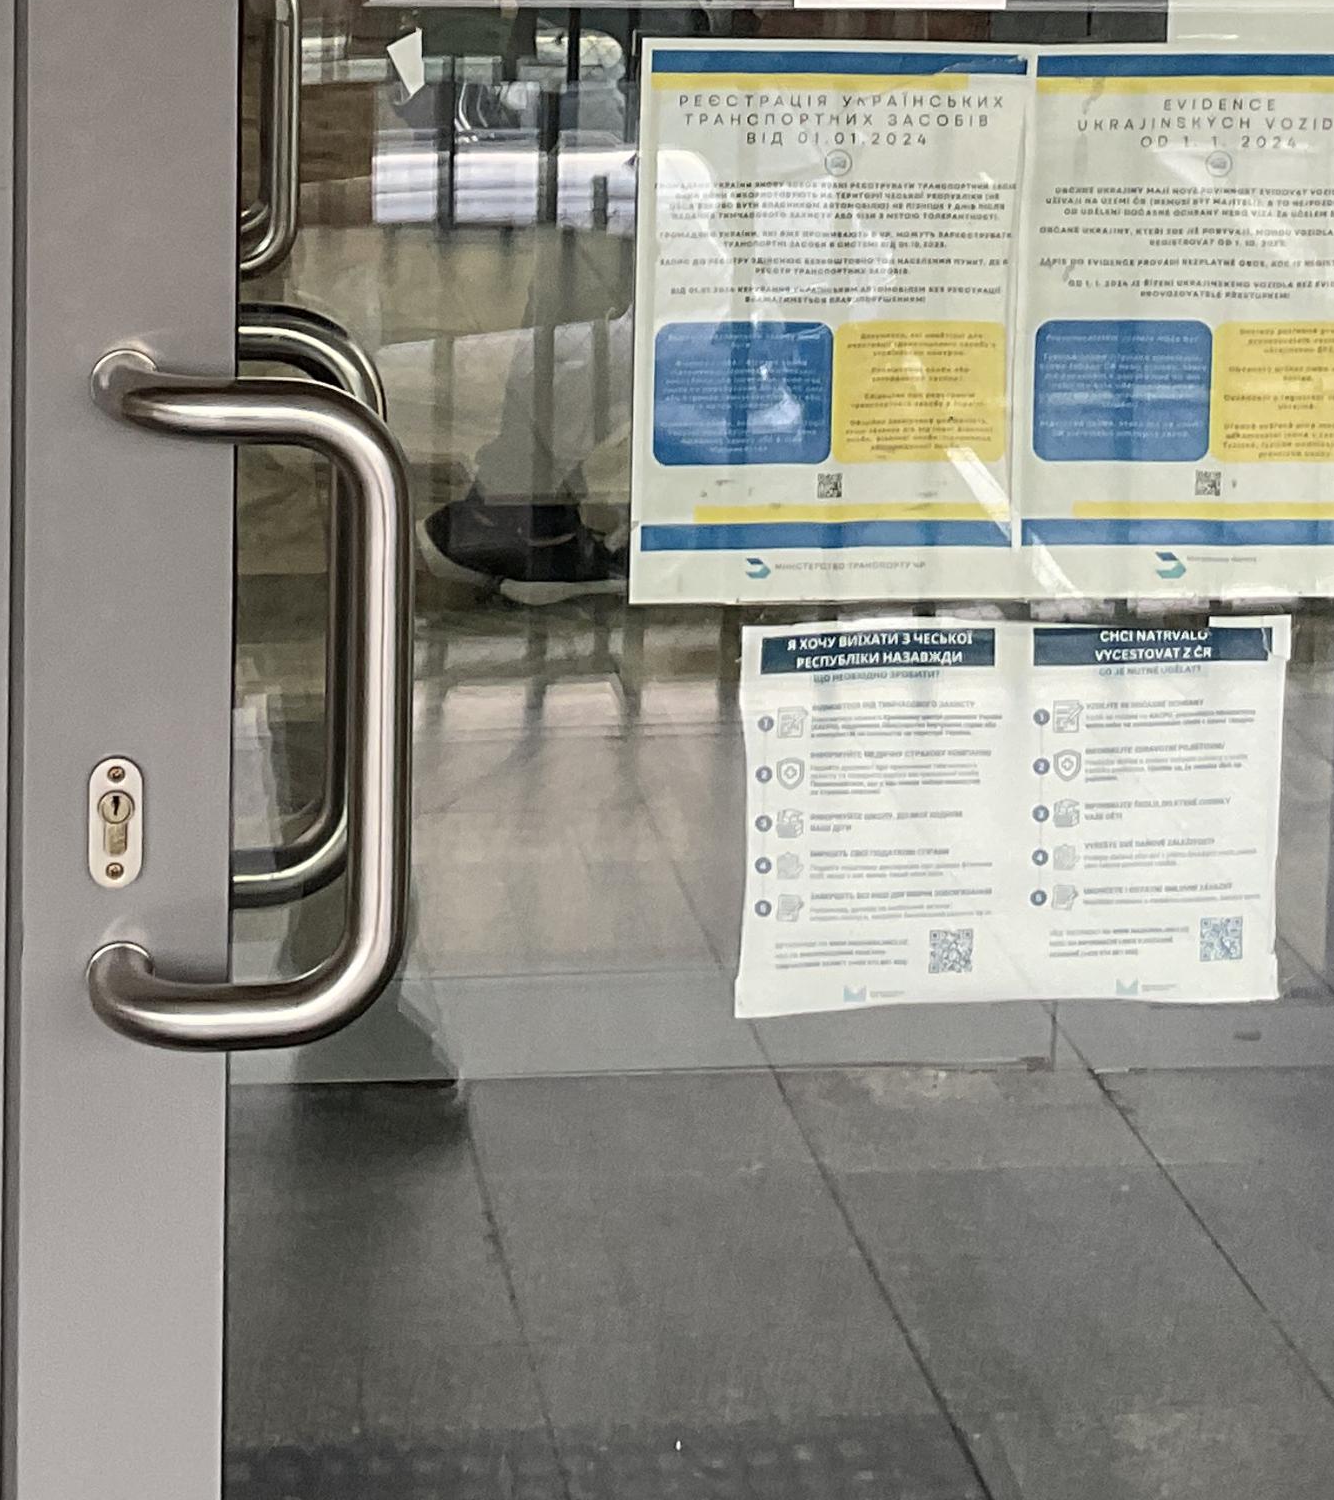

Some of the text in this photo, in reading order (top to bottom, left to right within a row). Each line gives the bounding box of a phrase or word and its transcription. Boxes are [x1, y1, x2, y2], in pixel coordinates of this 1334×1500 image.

[679, 91, 1004, 110] РЕЄСТРАЦІЯ УКРАЇНСЬКИХ
[1163, 98, 1276, 111] EVIDENCE
[685, 113, 989, 127] ТРАНСПОРТНИХ ЗАСОБІВ
[1078, 115, 1252, 132] UKRAJINSKÝCH
[746, 132, 928, 147] ВІД 01.01.2024
[1140, 136, 1169, 148] OD
[1183, 136, 1197, 148] 1.
[1241, 135, 1297, 148] 2024
[787, 631, 973, 651] Я ХОЧУ ВИЇХАТИ З ЧЕСЬКОЇ
[1100, 630, 1208, 642] CHCI NATRVALO
[797, 651, 963, 668] РЕСПУБЛІКИ НАЗАВЖДИ
[1095, 644, 1212, 661] VYCESTOVAT Z ČR
